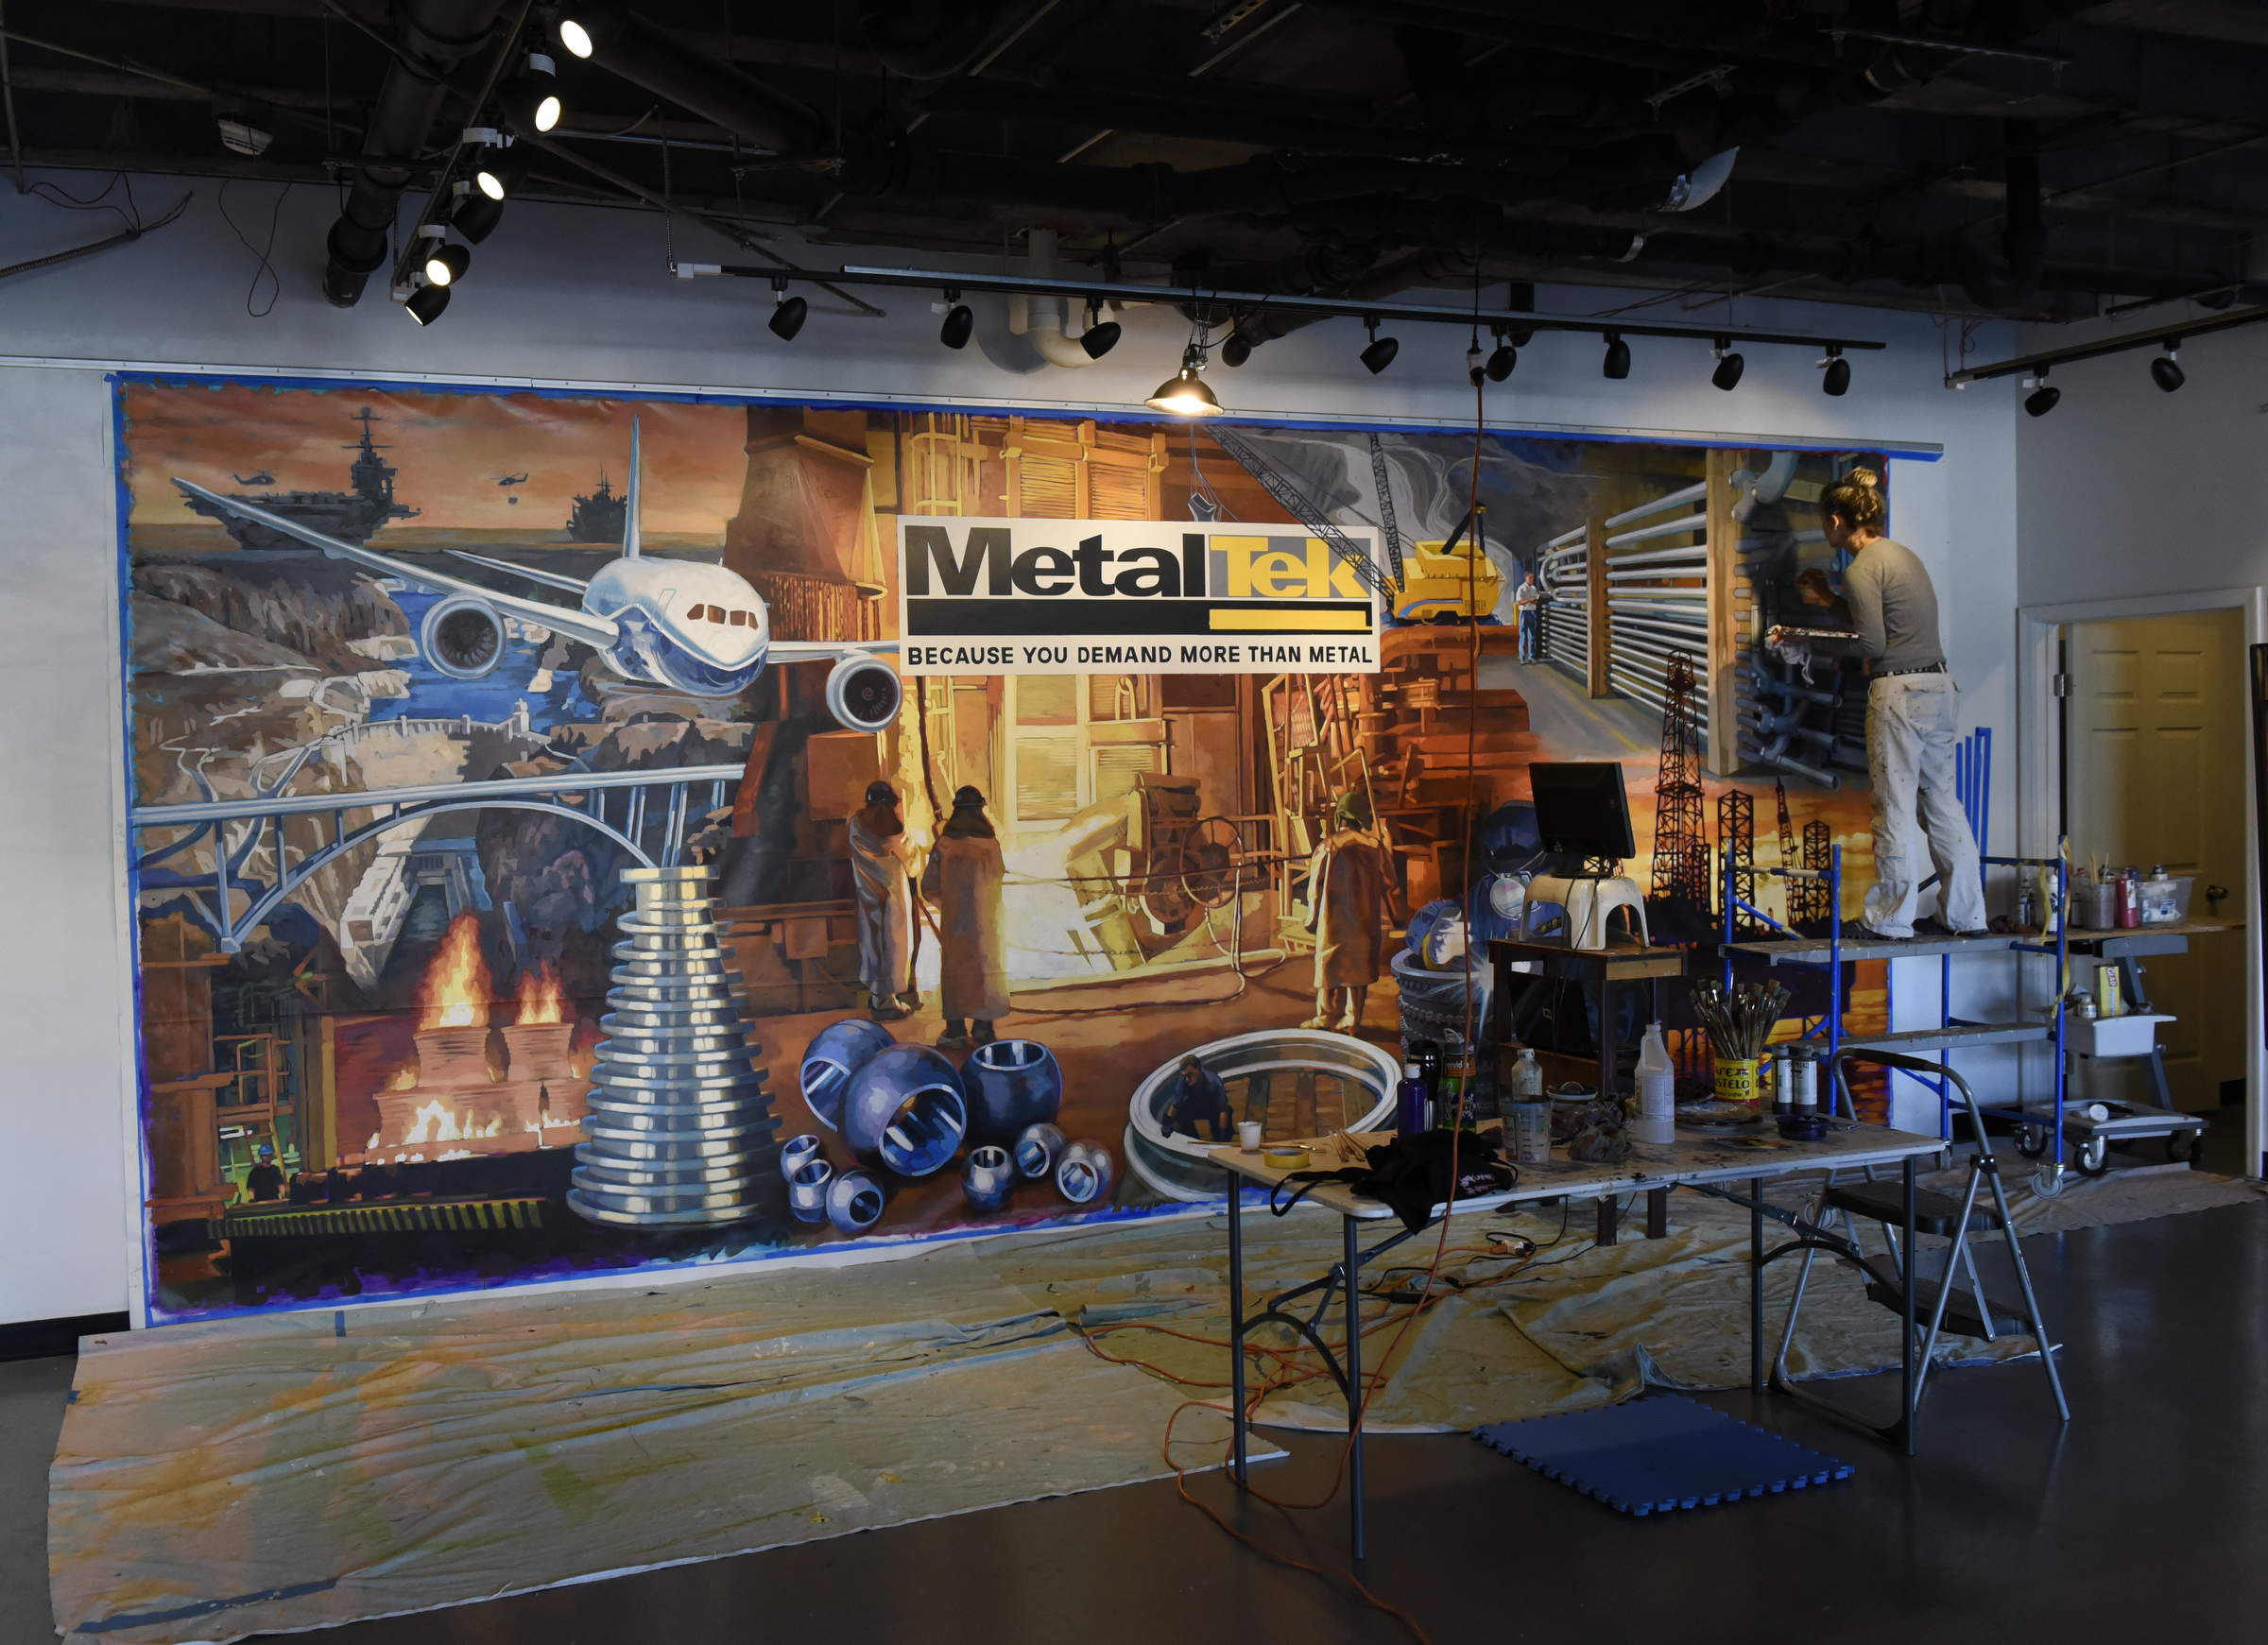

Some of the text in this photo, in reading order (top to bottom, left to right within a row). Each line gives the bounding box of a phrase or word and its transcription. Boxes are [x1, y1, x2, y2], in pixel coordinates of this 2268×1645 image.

[907, 645, 1373, 665] BECAUSE YOU DEMAND MORE THAN METAL
[2107, 967, 2117, 986] GLAD
[1715, 1077, 1750, 1089] STELO
